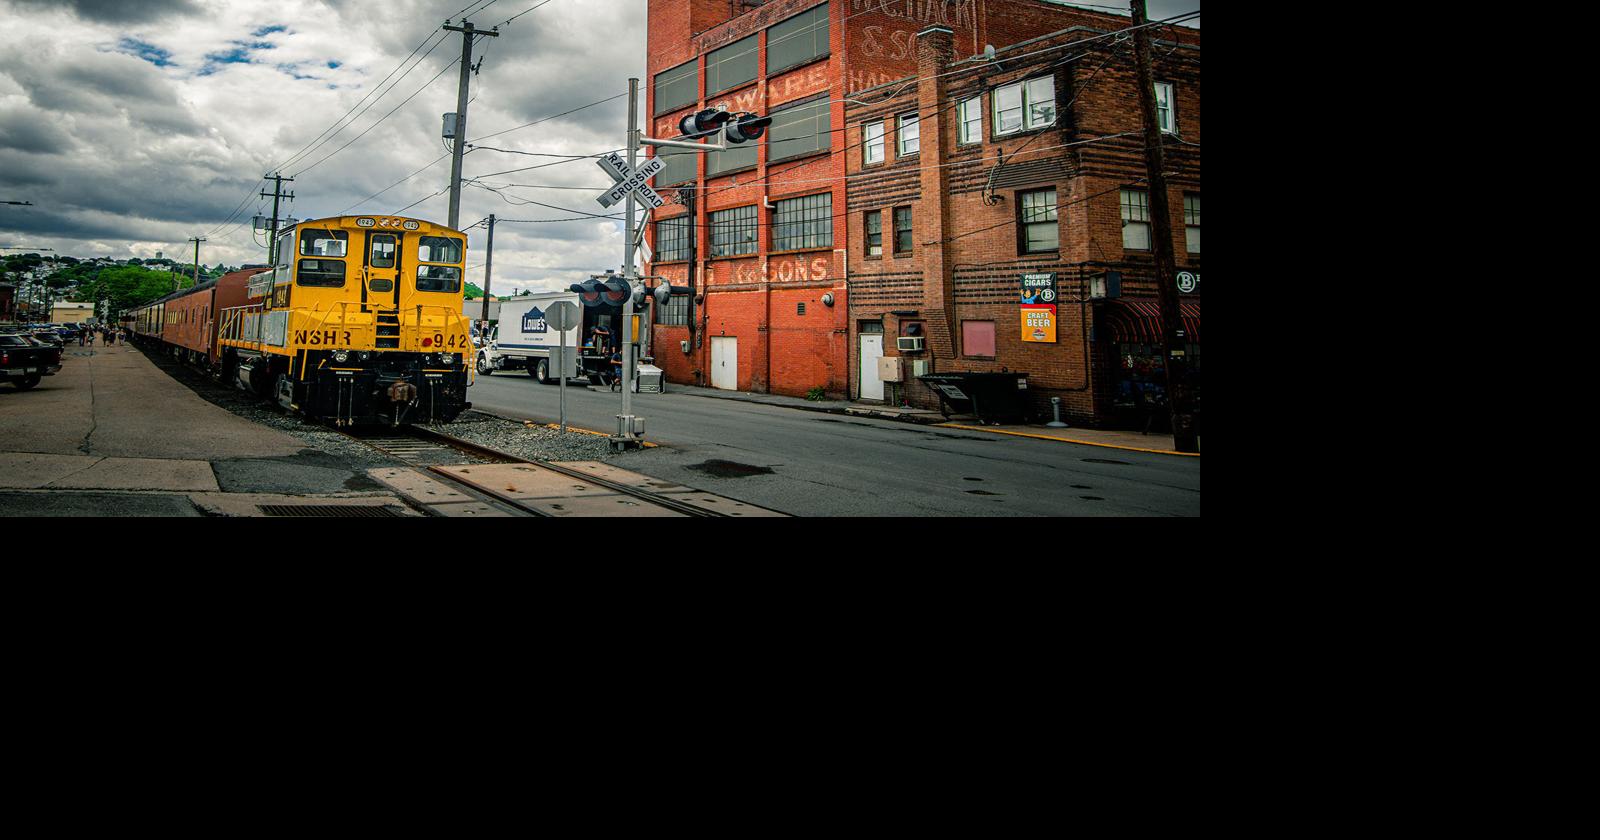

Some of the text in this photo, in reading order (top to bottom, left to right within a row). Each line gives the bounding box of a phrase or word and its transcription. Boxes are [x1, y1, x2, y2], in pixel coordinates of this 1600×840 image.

[608, 154, 630, 178] RAIL
[611, 161, 661, 201] CROSSING
[637, 183, 663, 208] ROAD
[760, 257, 828, 283] SONS
[1024, 279, 1051, 287] CIGARS
[1027, 319, 1050, 327] BEER
[294, 329, 351, 345] NSHR
